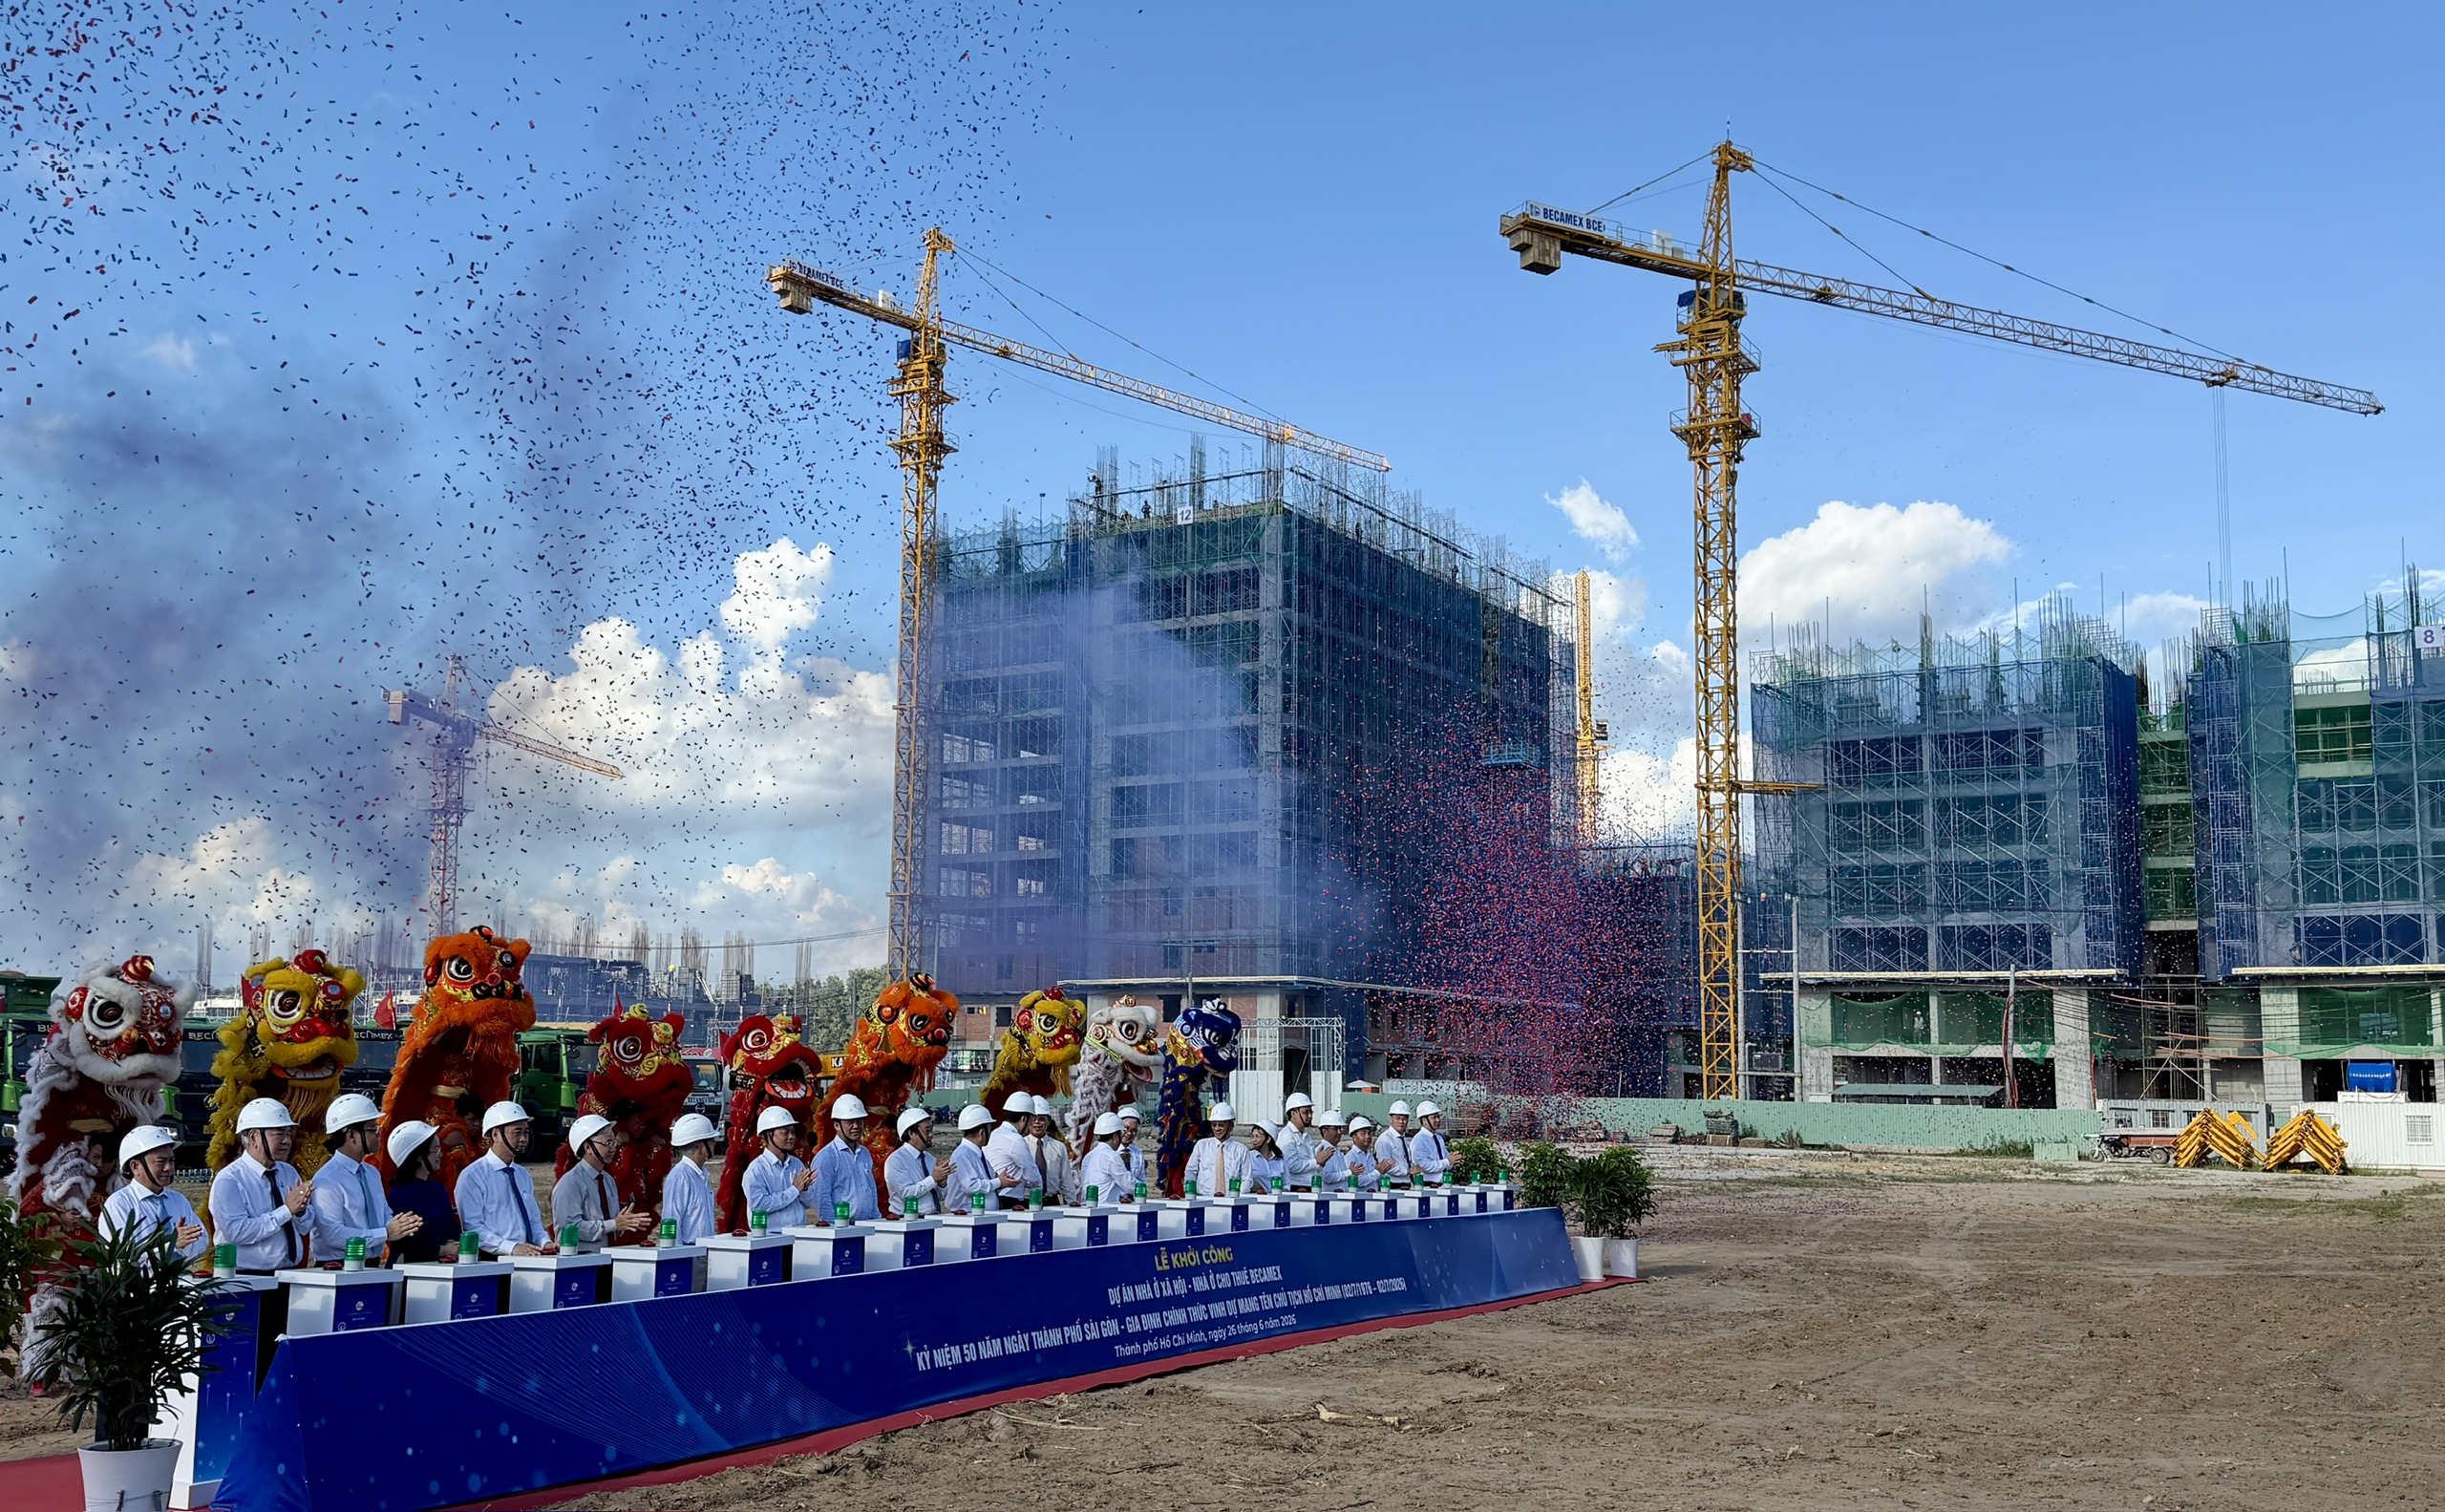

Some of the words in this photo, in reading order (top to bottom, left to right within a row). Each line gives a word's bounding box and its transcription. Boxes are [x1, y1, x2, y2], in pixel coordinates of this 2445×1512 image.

[1543, 207, 1584, 228] BECAMEX
[1586, 218, 1603, 232] BCE
[1180, 509, 1192, 522] 12
[2423, 629, 2434, 644] 8
[354, 1030, 393, 1039] ECAMEX
[1154, 1246, 1170, 1271] LỄ
[1171, 1245, 1201, 1268] KHỞI
[1202, 1245, 1234, 1265] CÔNG
[1108, 1286, 1121, 1308] DỰ
[1121, 1283, 1136, 1303] ÁN
[1135, 1280, 1154, 1301] NHÀ
[1153, 1277, 1160, 1298] Ở
[1159, 1277, 1173, 1297] XÃ
[1173, 1275, 1187, 1298] HỘI
[1192, 1272, 1210, 1292] NHÀ
[1209, 1269, 1216, 1289] Ở
[1216, 1272, 1232, 1288] CHO
[1231, 1267, 1250, 1287] THUÊ
[1249, 1265, 1283, 1284] BECAMEX
[916, 1344, 931, 1371] KỶ
[932, 1343, 962, 1370] NIỆM
[963, 1343, 977, 1362] 50
[977, 1335, 1003, 1359] NĂM
[1004, 1331, 1030, 1355] NGÀY
[1031, 1326, 1063, 1350] THÀNH
[1063, 1318, 1083, 1344] PHỐ
[1084, 1319, 1100, 1341] SÀI
[1100, 1316, 1120, 1338] GÒN
[1125, 1315, 1141, 1333] GIA
[1140, 1311, 1162, 1333] ĐỊNH
[1162, 1306, 1188, 1327] CHÍNH
[1187, 1302, 1208, 1323] THỨC
[1207, 1302, 1227, 1319] VINH
[1226, 1298, 1238, 1318] DỰ
[1237, 1296, 1260, 1314] MANG
[1259, 1291, 1274, 1310] TÊN
[1273, 1287, 1288, 1309] CHỦ
[1287, 1289, 1304, 1309] TỊCH
[1312, 1284, 1326, 1302] CHÍ
[1324, 1285, 1343, 1300] MINH
[1114, 1342, 1141, 1357] Thành
[1142, 1336, 1159, 1355] phố
[1172, 1332, 1185, 1347] Chí
[1186, 1330, 1208, 1344] Minh,
[1208, 1326, 1226, 1342] ngày
[1226, 1324, 1237, 1336] 26
[1237, 1322, 1259, 1334] tháng
[1259, 1319, 1265, 1331] 6
[1265, 1317, 1280, 1329] năm
[1281, 1313, 1297, 1327] 2026
